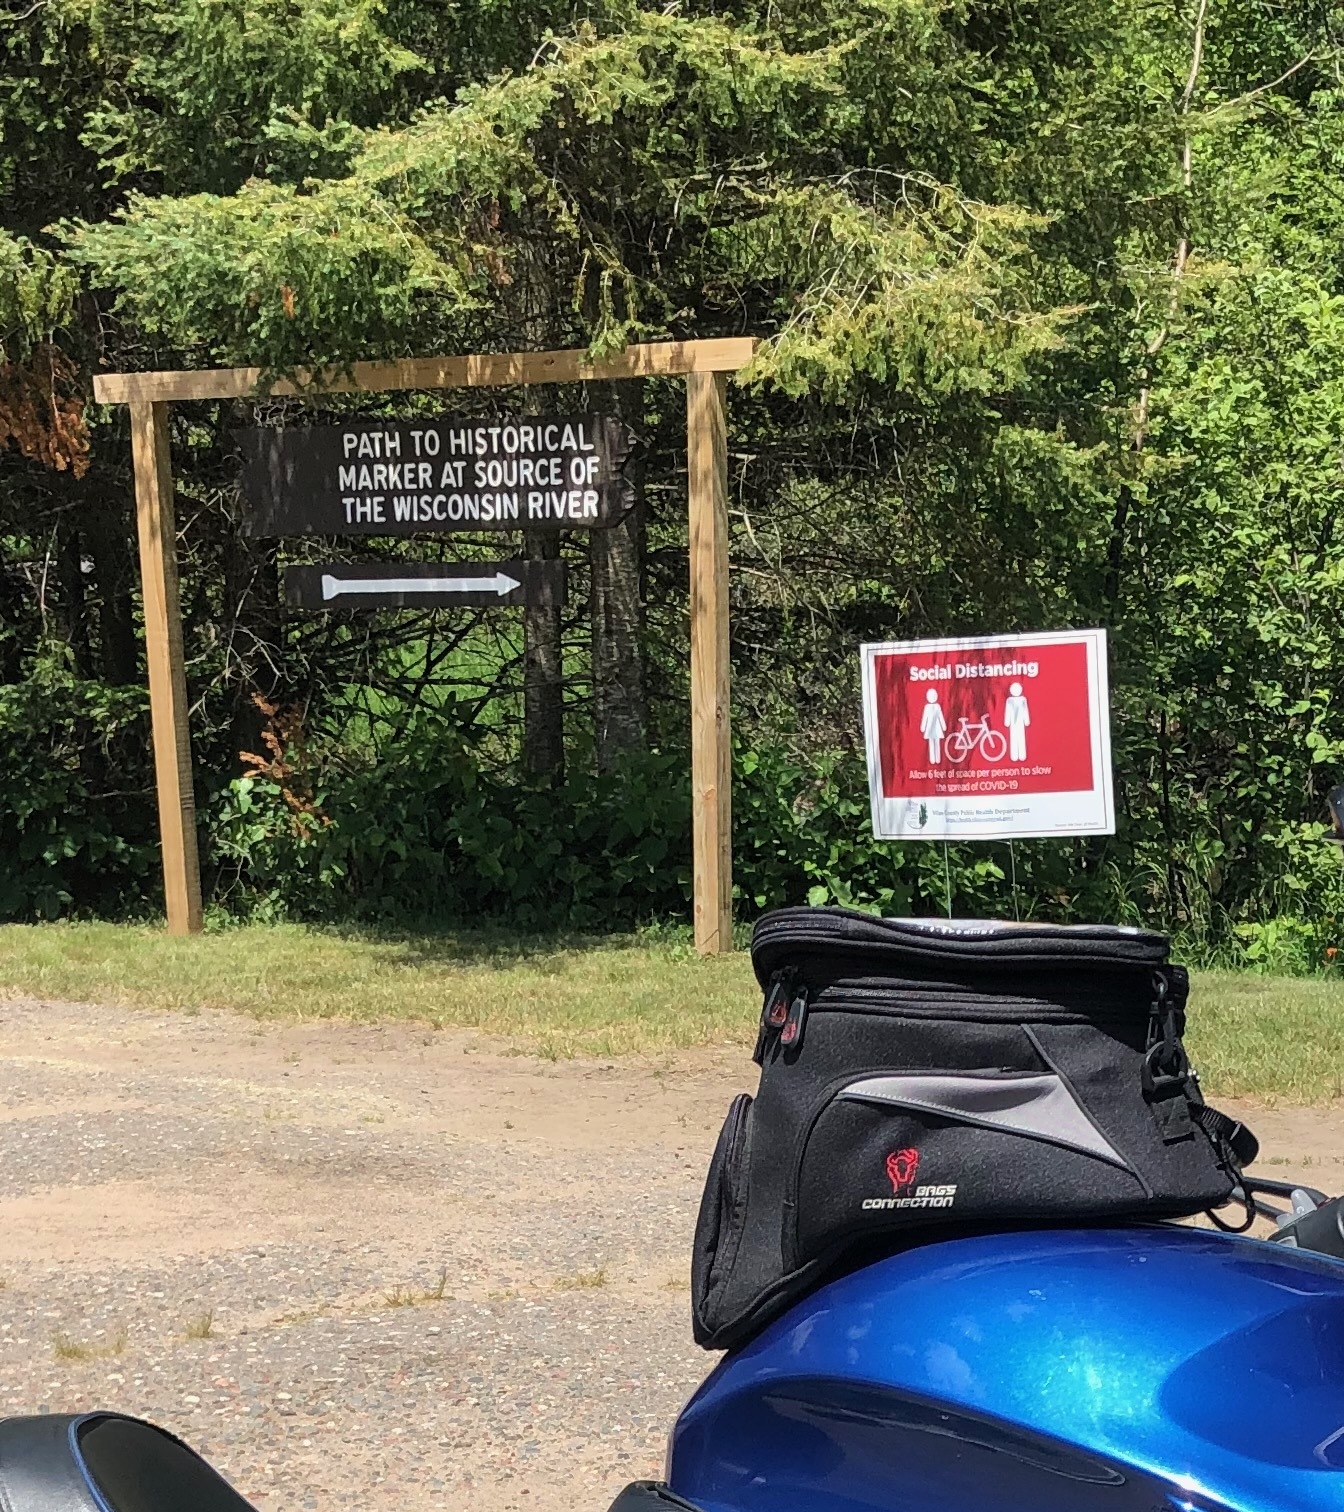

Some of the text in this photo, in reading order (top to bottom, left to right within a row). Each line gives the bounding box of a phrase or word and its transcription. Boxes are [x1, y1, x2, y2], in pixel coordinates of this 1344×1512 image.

[343, 423, 594, 458] PATH TO HISTORICAL
[338, 456, 600, 491] MARKER AT SOURCE OF
[342, 490, 598, 524] THE WISCONSIN RIVER
[910, 660, 1039, 681] Social Distancing
[909, 770, 927, 779] Allow
[956, 769, 976, 780] space
[976, 768, 990, 779] per
[991, 767, 1020, 779] person
[1021, 767, 1031, 776] to
[1032, 766, 1052, 775] slow
[979, 780, 1019, 791] COVID-19
[915, 1184, 958, 1197] BAGS
[862, 1196, 954, 1210] CONNECTION
